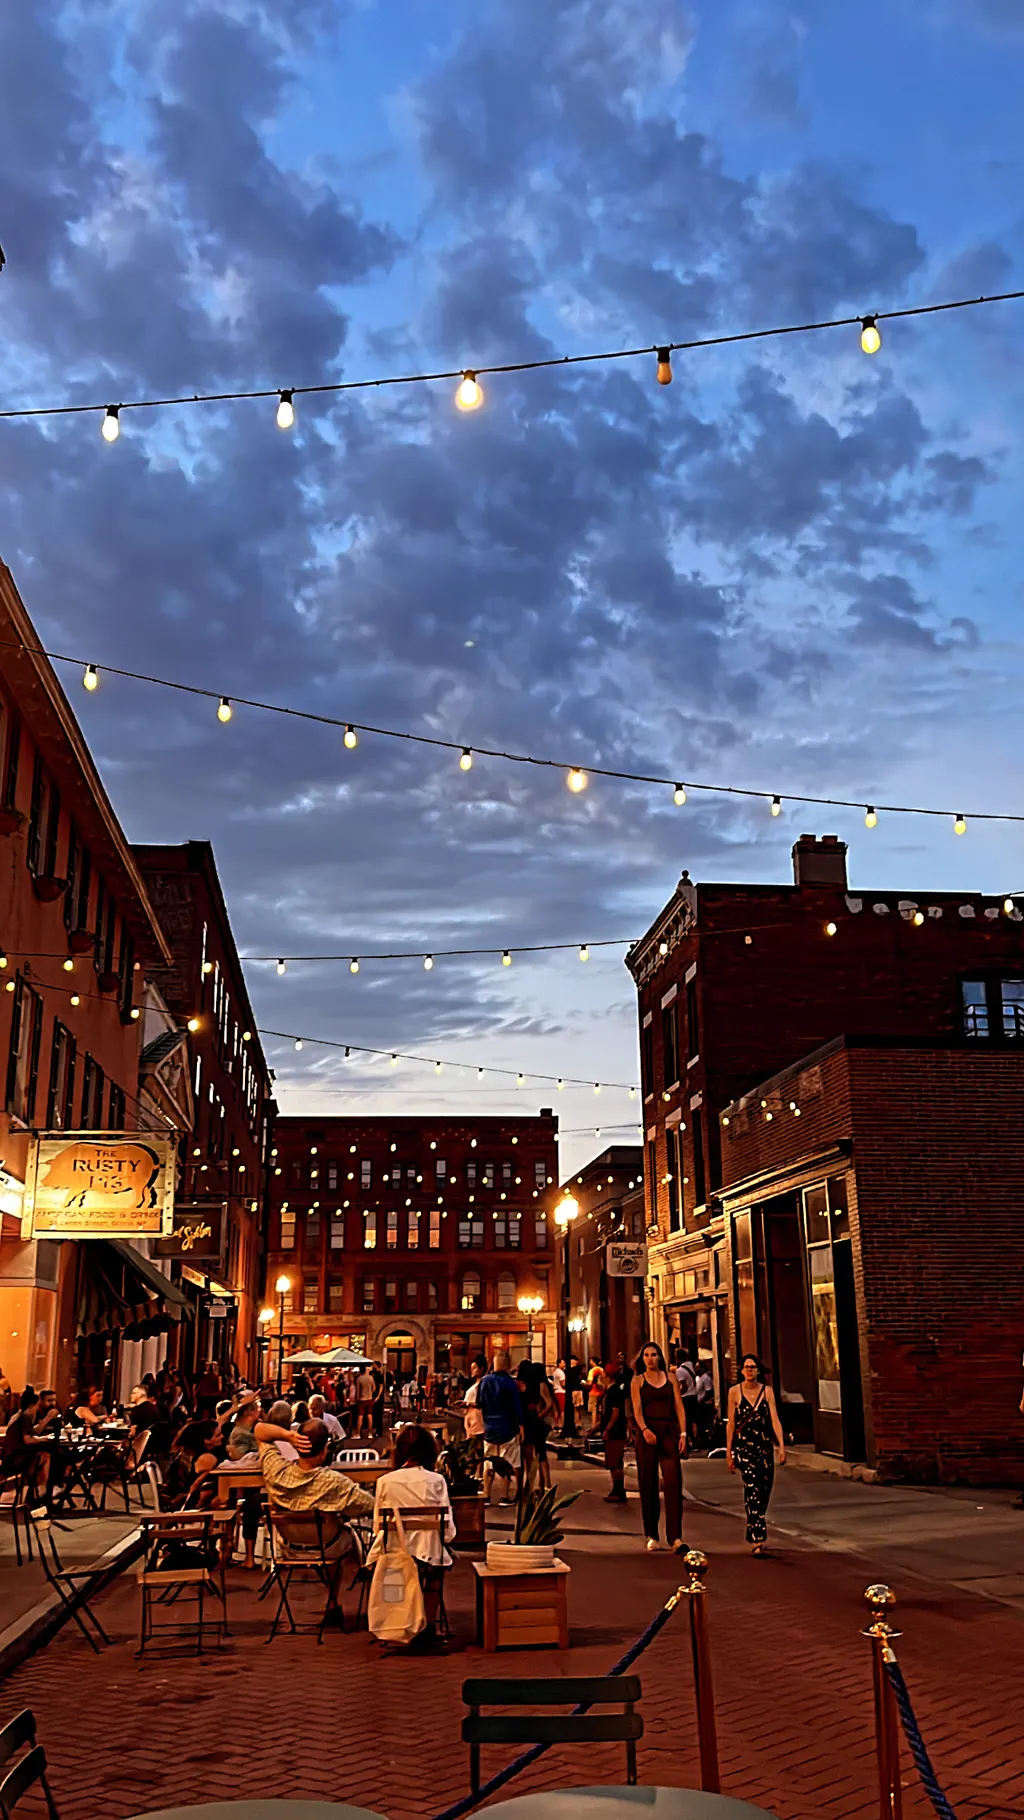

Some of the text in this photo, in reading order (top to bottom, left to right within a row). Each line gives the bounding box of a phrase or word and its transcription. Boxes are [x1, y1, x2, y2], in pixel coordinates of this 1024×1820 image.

[95, 1149, 118, 1157] THE
[73, 1159, 141, 1172] RUSTY
[89, 1175, 123, 1188] PIG
